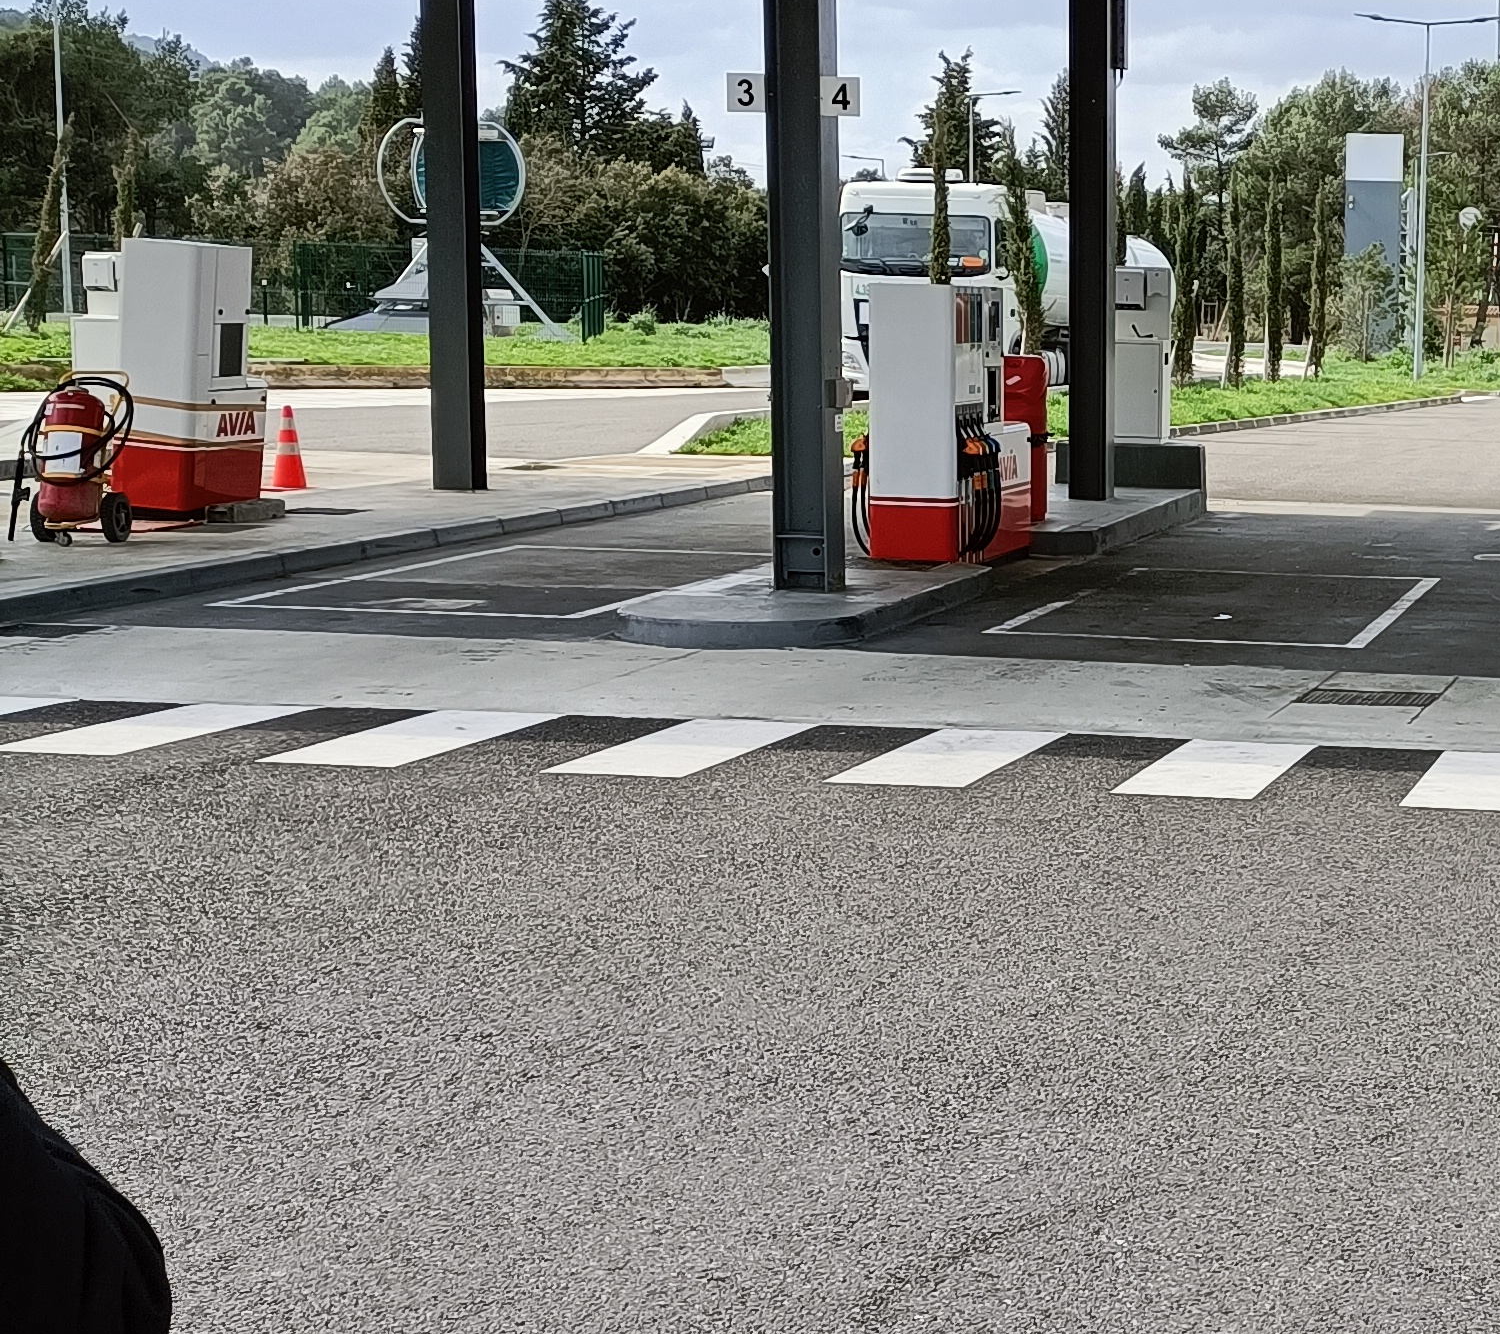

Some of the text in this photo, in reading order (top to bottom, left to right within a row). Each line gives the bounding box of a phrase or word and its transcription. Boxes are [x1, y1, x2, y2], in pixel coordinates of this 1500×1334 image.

[737, 78, 755, 107] 3
[831, 82, 851, 111] 4
[216, 411, 256, 438] AVIA
